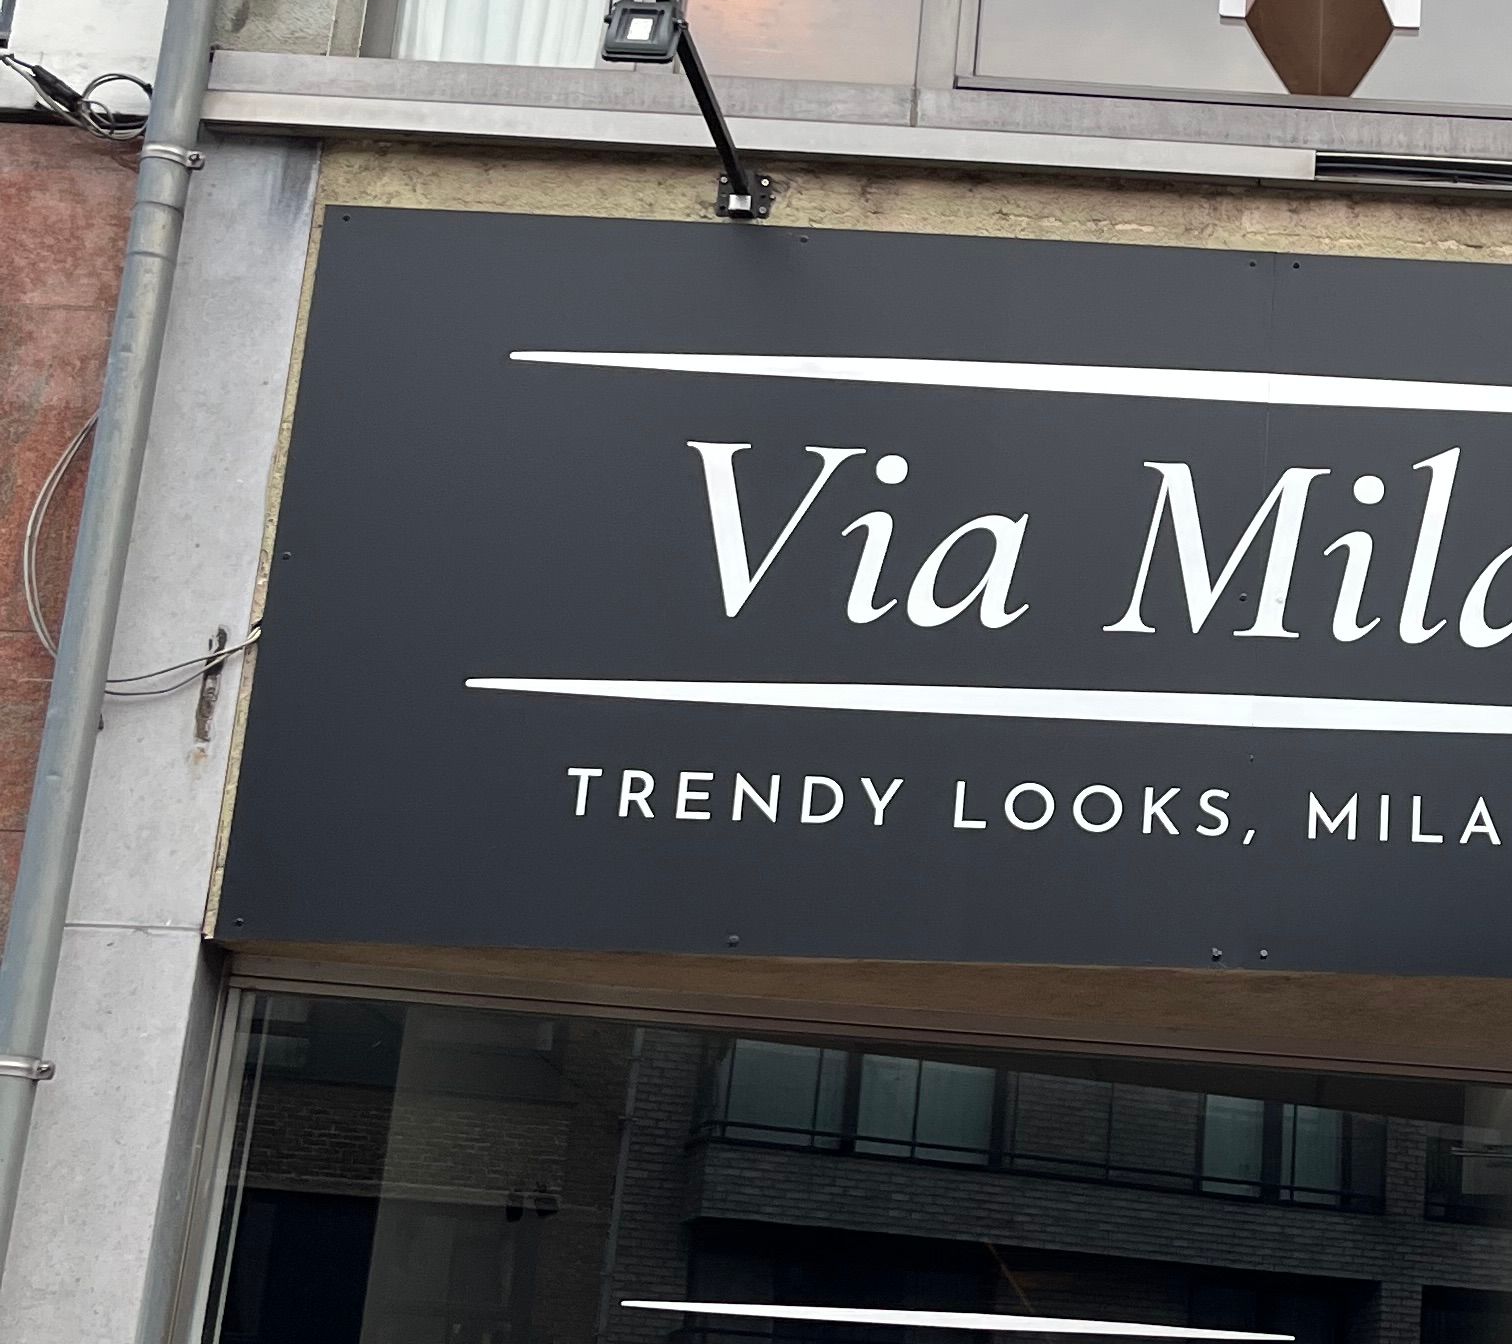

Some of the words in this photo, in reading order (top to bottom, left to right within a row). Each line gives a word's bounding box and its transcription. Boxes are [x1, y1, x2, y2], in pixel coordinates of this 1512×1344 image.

[686, 440, 1030, 629] Via
[567, 767, 904, 826] TRENDY
[953, 780, 1256, 846] LOOKS,
